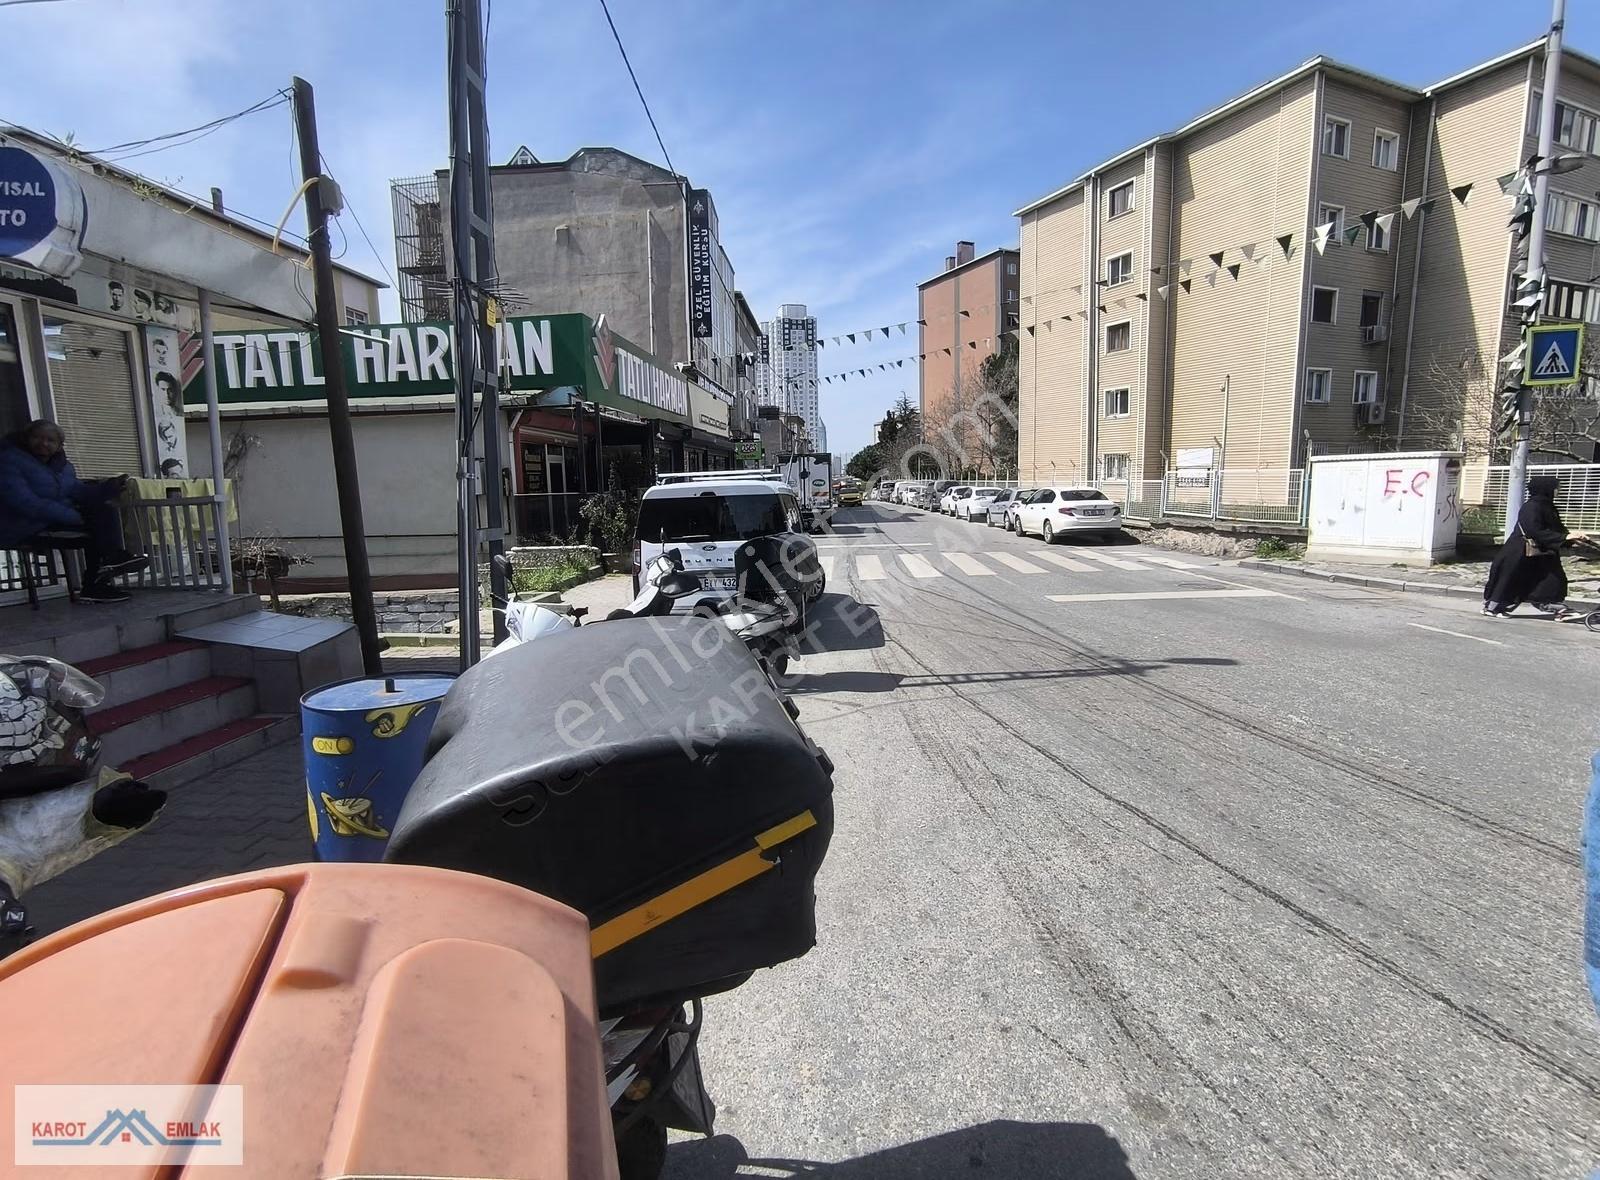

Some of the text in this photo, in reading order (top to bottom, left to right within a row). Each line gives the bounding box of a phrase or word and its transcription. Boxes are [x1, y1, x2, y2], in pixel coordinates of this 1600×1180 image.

[692, 224, 703, 319] ÖZEL GÜVENLİK
[701, 229, 711, 313] EĞİTİM KURSU
[213, 319, 554, 389] TATL HARAN
[615, 347, 651, 404] TATLI
[650, 364, 688, 417] HARMAN
